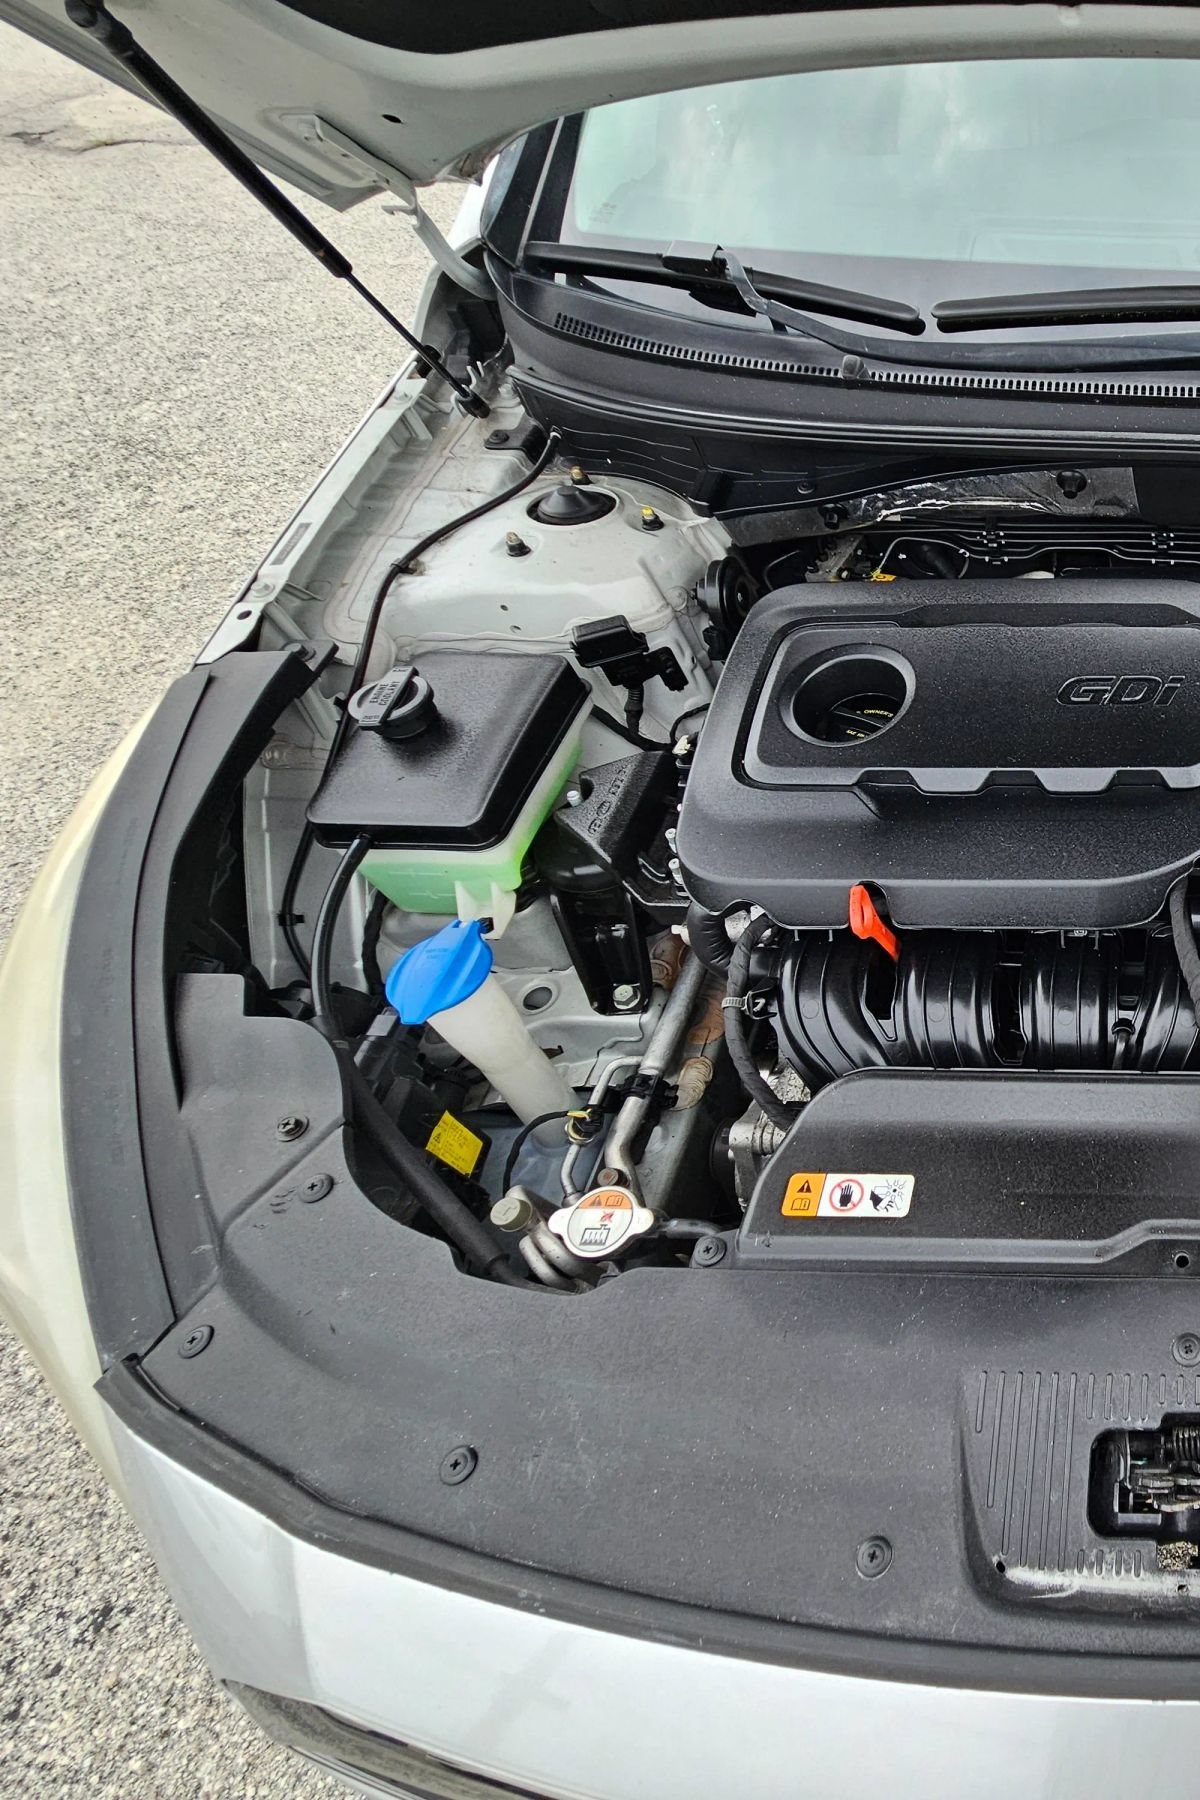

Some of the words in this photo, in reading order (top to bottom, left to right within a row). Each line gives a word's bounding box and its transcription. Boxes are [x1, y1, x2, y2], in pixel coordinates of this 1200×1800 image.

[369, 683, 389, 703] ENGINE
[379, 681, 401, 705] COOLANT
[1056, 675, 1185, 705] GDi
